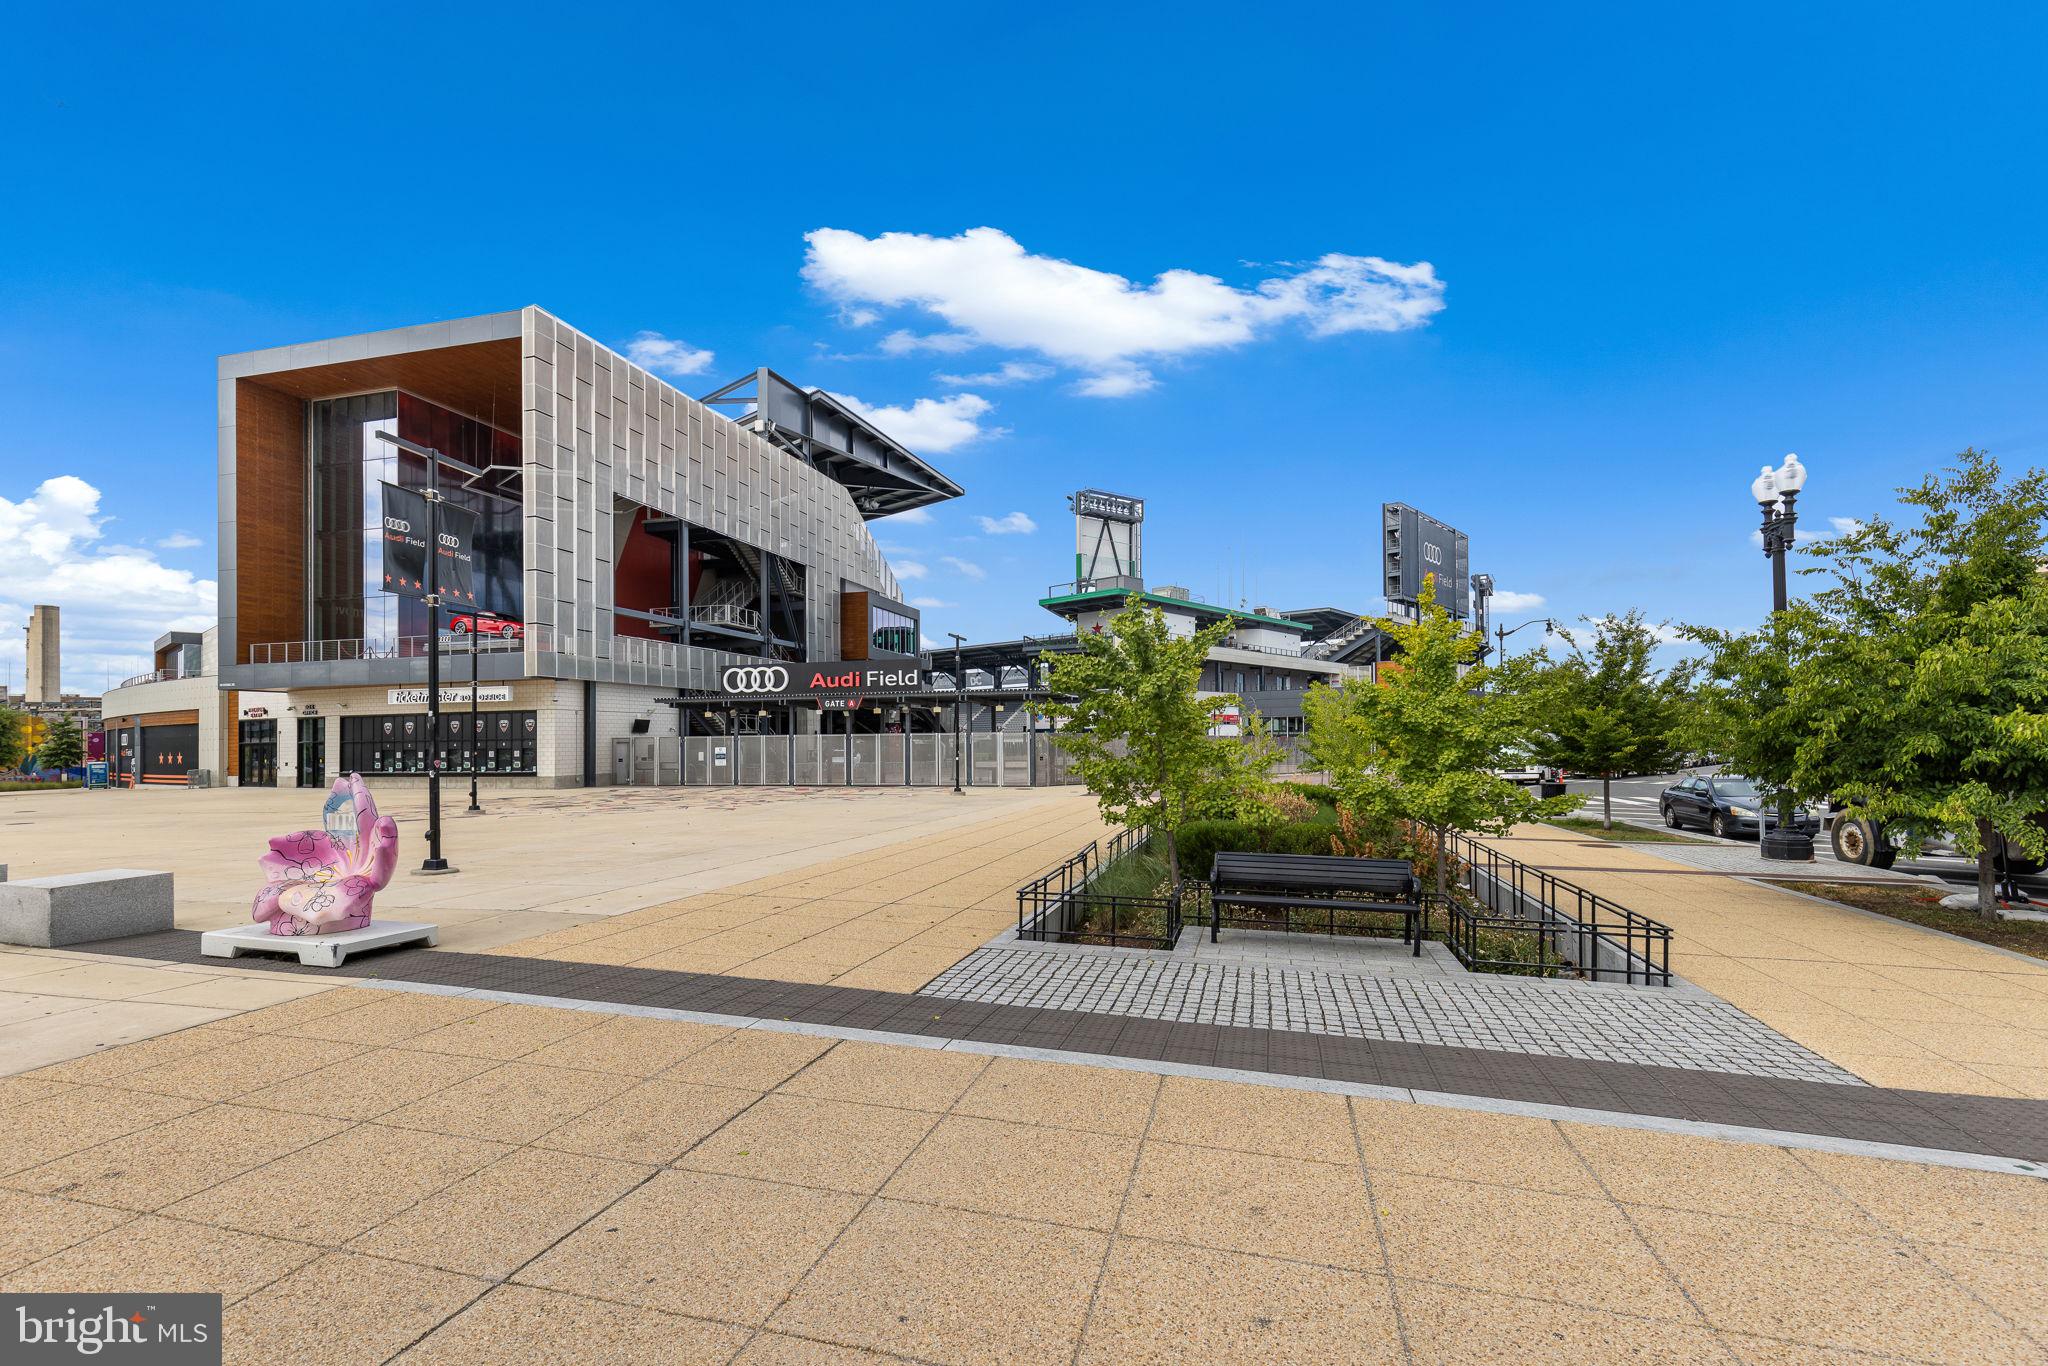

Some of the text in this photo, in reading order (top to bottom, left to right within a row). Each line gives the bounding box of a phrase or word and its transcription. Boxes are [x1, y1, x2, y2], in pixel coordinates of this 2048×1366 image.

[384, 531, 426, 548] Audi Field
[438, 547, 471, 562] Audi Field
[810, 669, 918, 688] Audi Field
[825, 700, 845, 708] GATE
